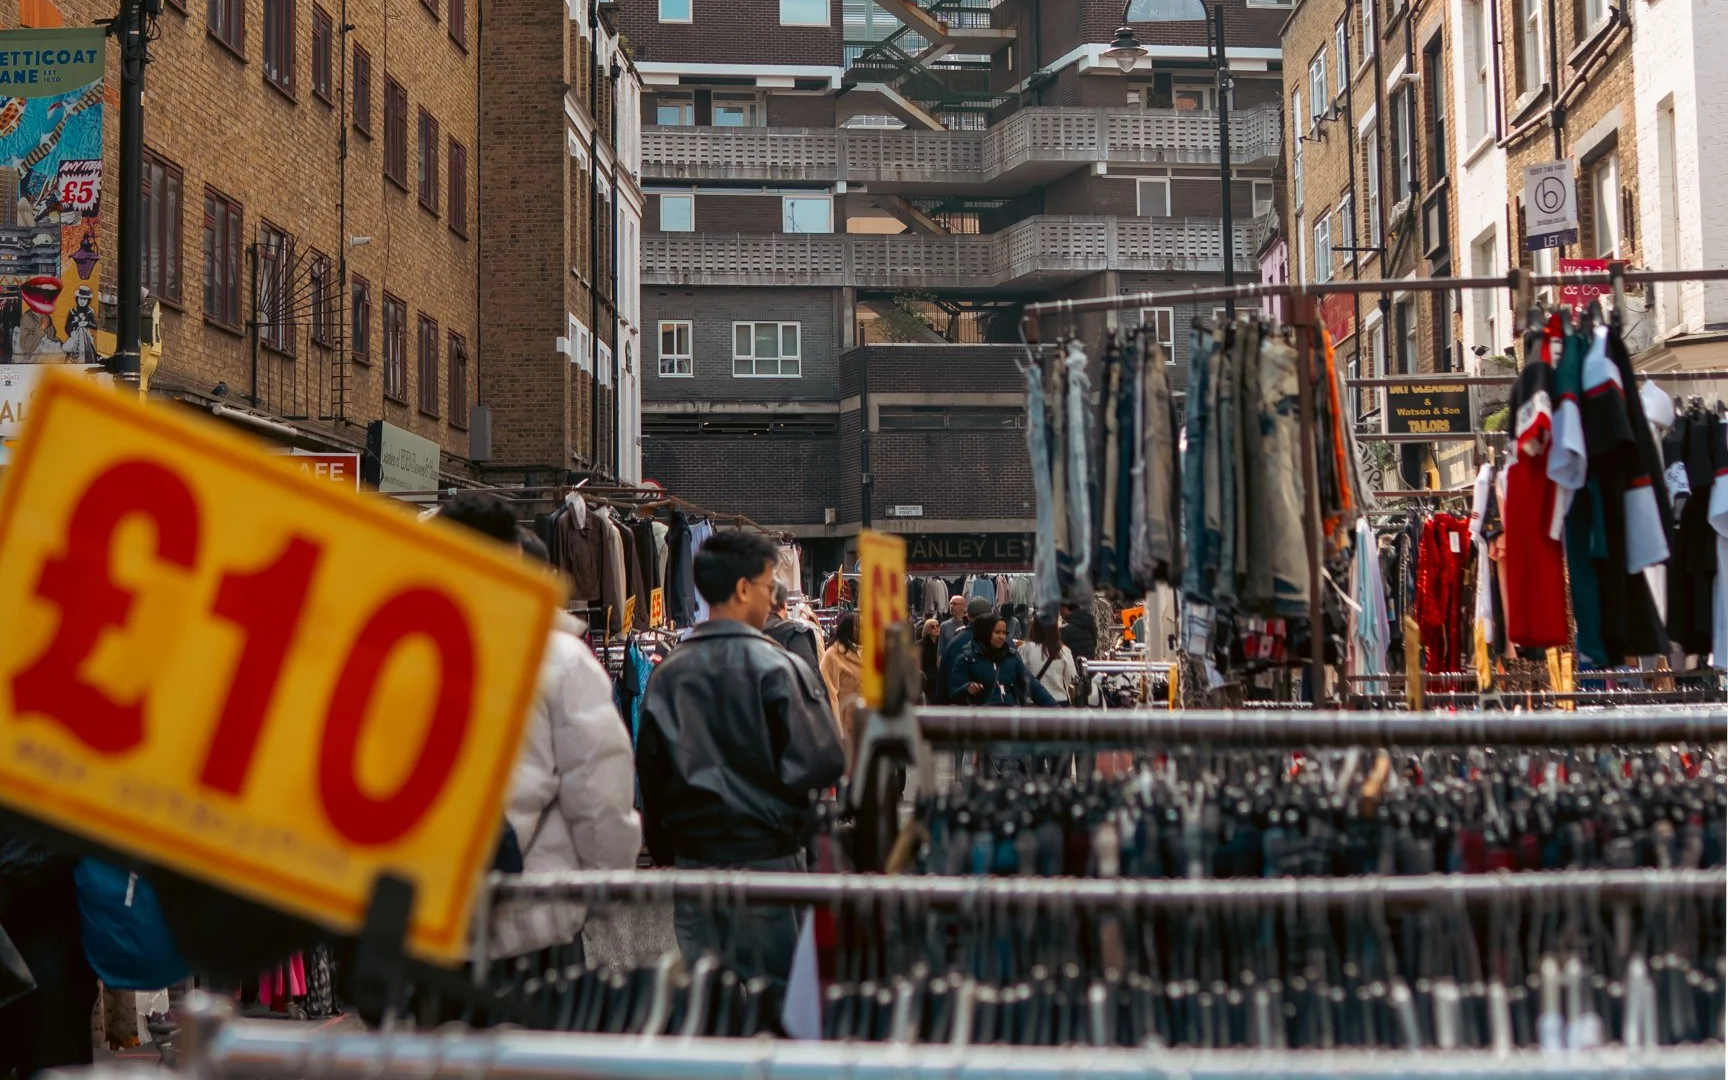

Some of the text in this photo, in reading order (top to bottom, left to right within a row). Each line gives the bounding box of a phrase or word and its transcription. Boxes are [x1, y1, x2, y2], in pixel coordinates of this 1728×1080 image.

[61, 180, 94, 204] £5
[1543, 235, 1560, 248] LET
[1563, 284, 1600, 296] & Co
[1424, 398, 1432, 406] &
[1396, 406, 1460, 416] Watson & Son
[1408, 419, 1450, 433] TAILORS
[300, 462, 345, 482] AFE
[909, 539, 986, 558] ANLEY
[10, 457, 478, 848] £10
